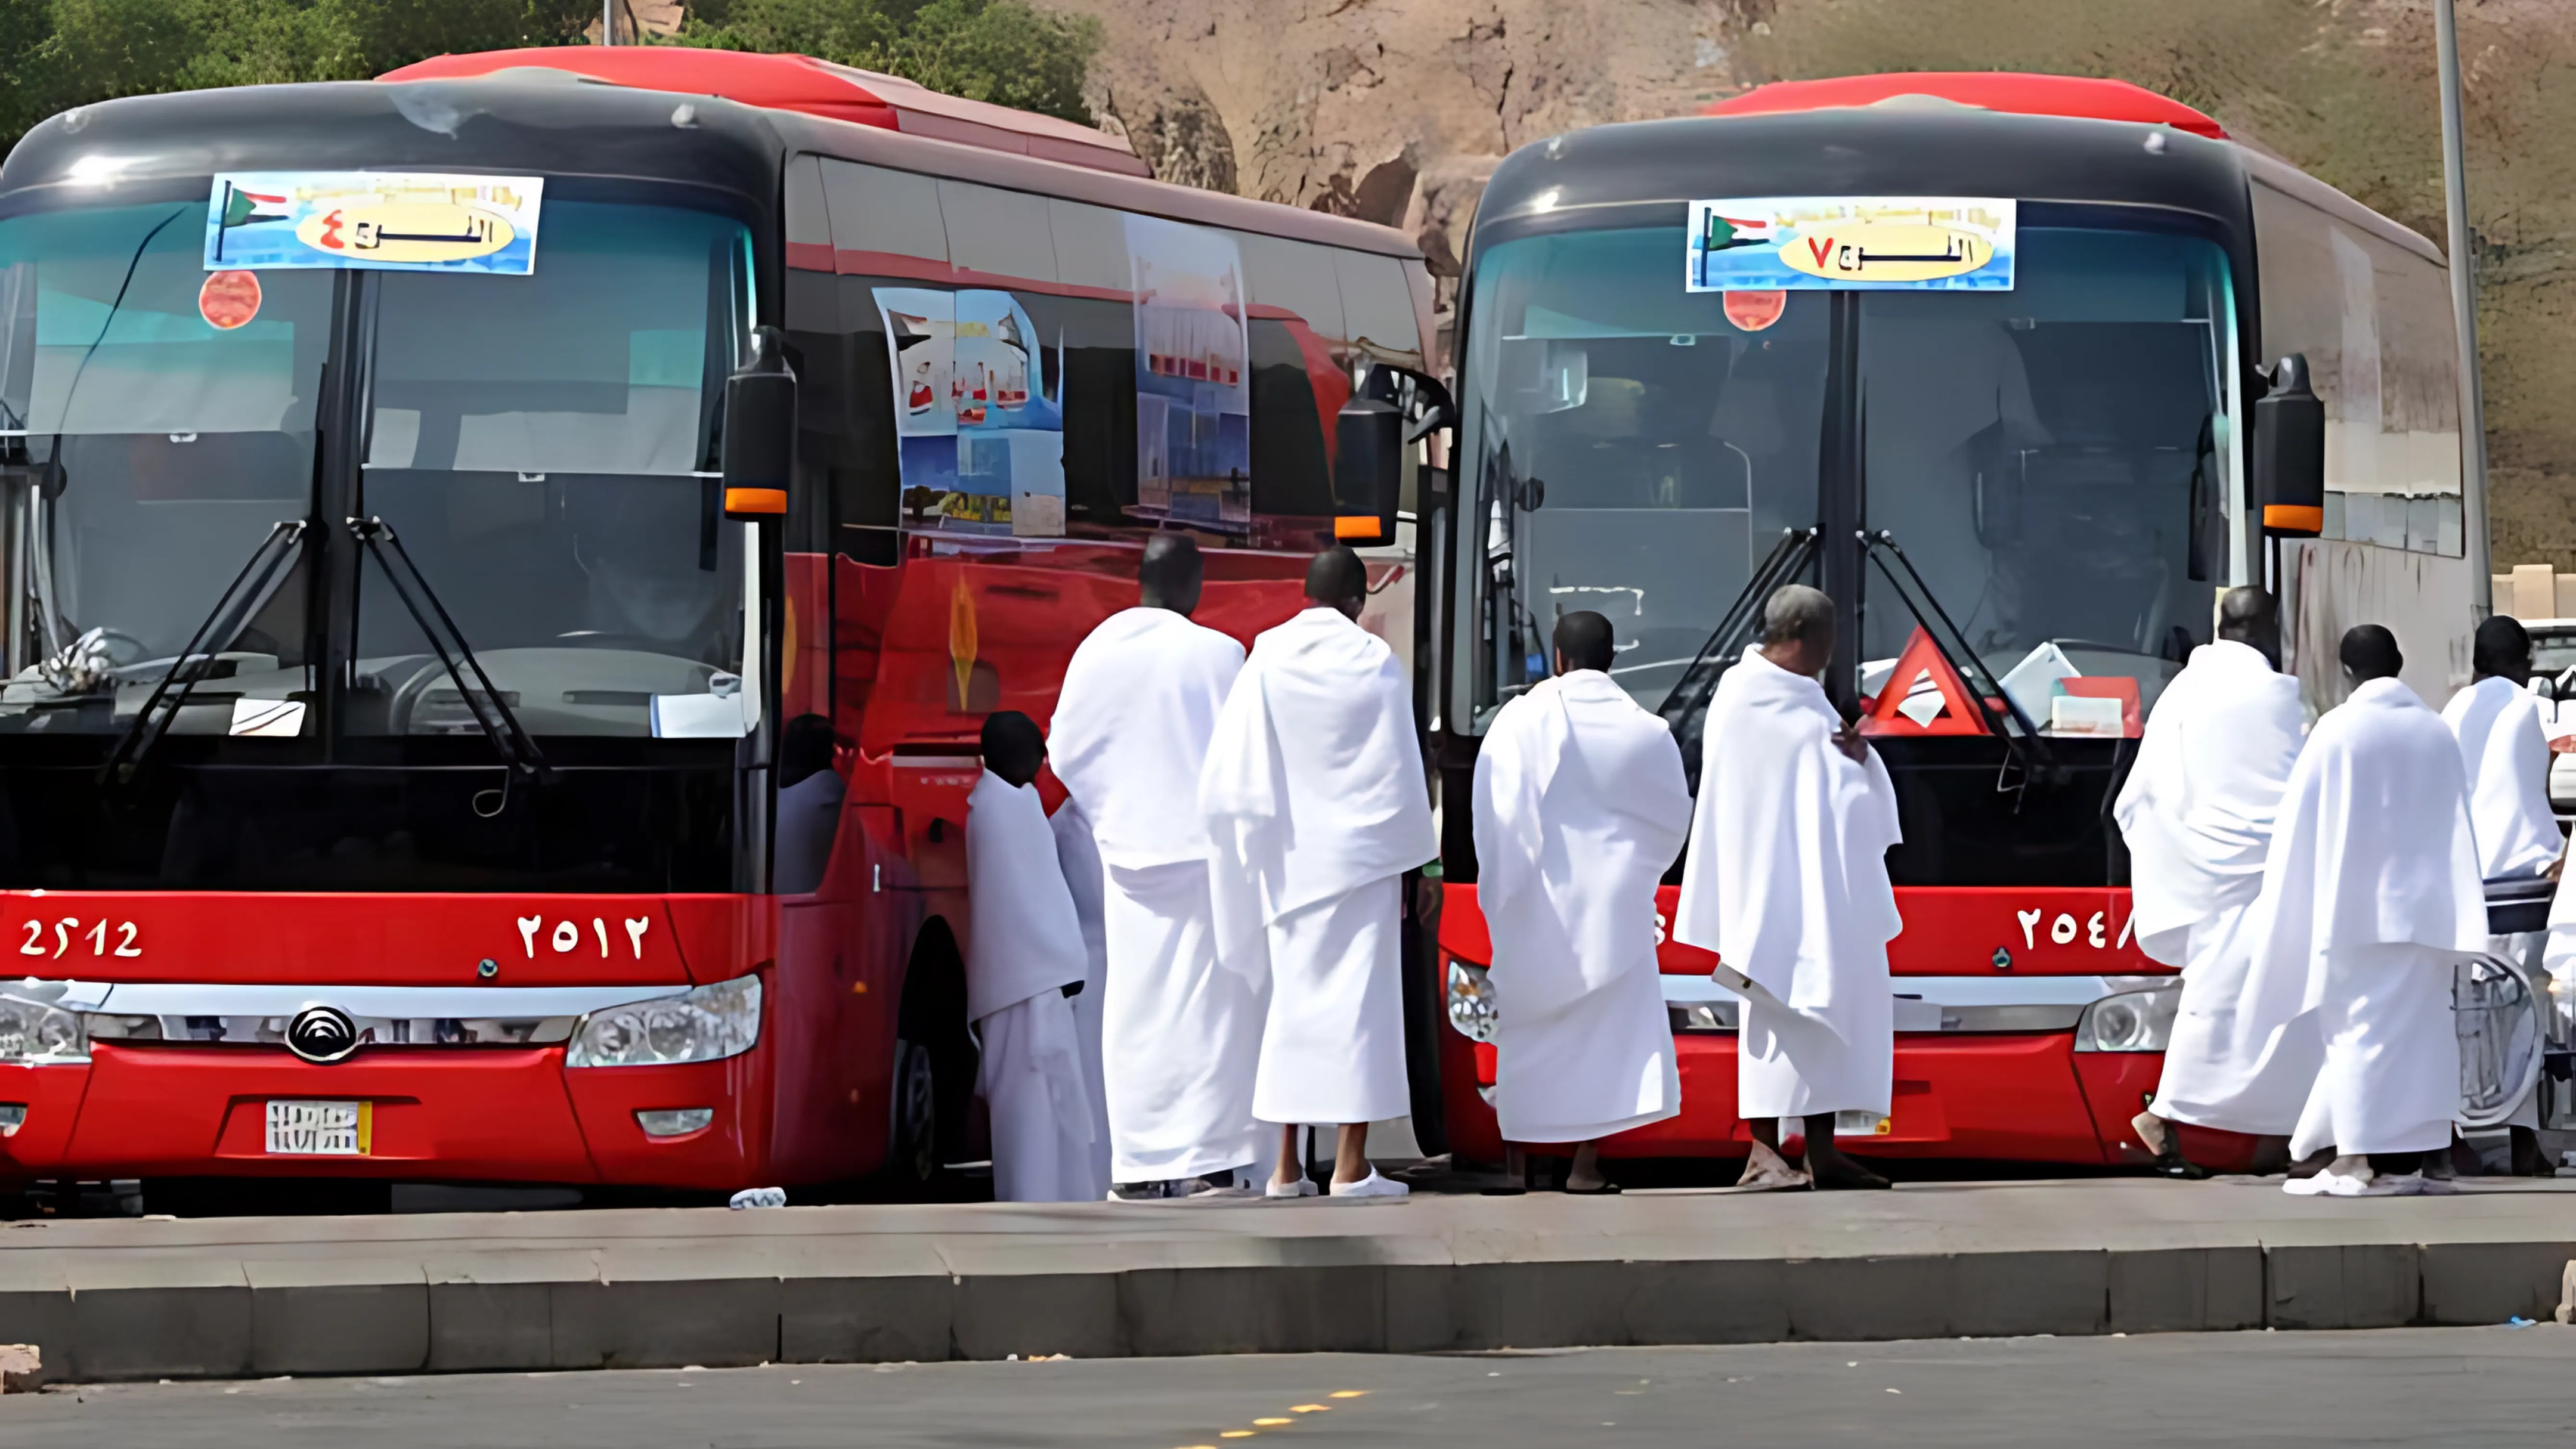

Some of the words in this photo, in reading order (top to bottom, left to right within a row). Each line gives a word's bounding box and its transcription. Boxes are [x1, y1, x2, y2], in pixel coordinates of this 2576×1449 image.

[320, 209, 345, 249] ٤
[1808, 236, 1834, 268] ٧
[20, 917, 142, 959] 2512
[517, 915, 649, 959] ٢٥١٢
